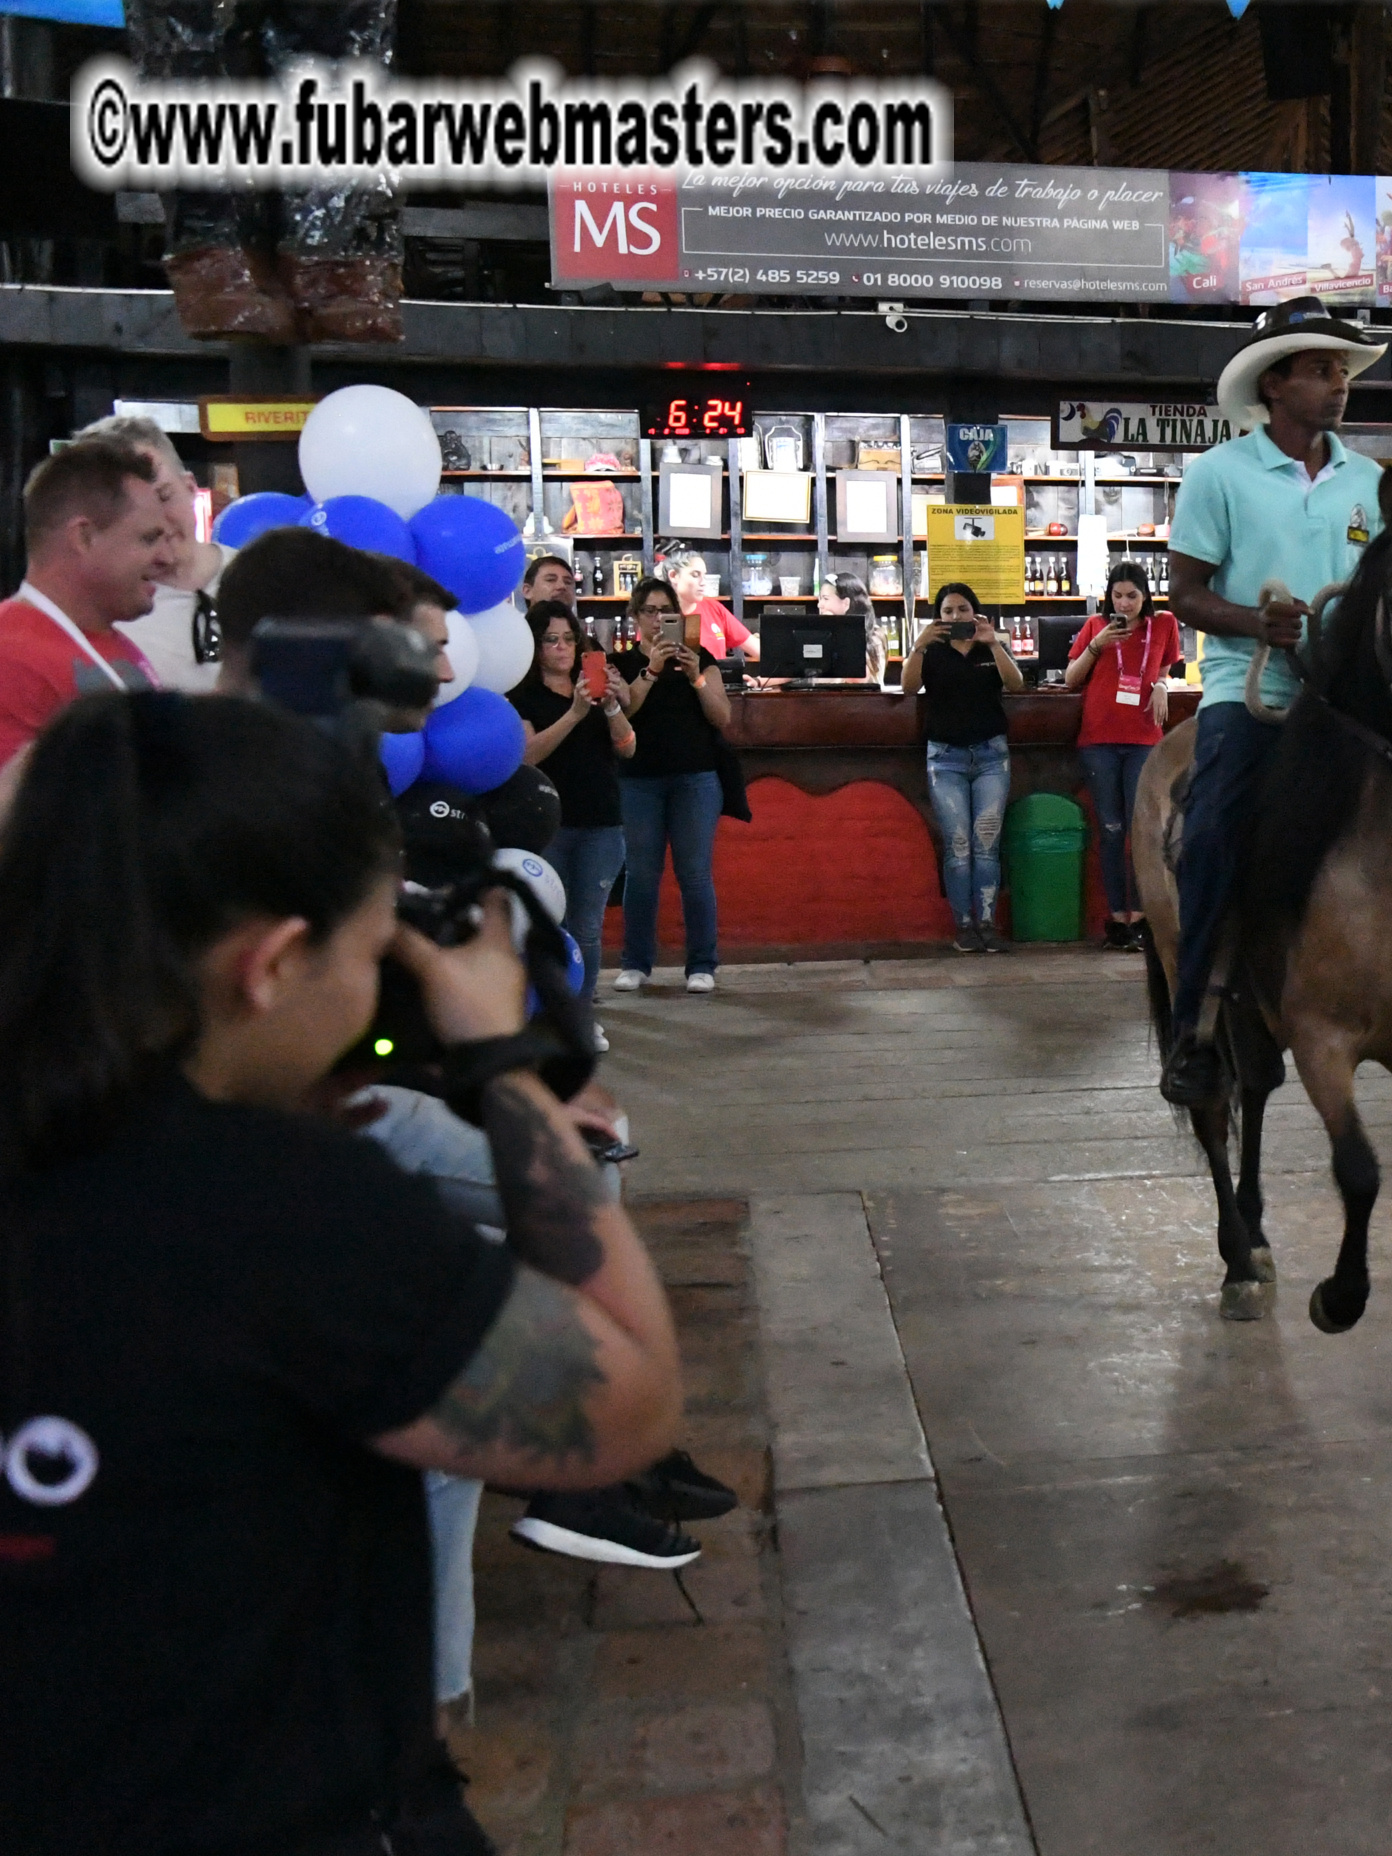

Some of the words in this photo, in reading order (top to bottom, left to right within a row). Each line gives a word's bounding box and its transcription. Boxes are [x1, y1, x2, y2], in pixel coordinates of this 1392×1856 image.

[573, 181, 658, 195] HOTELES
[711, 171, 768, 198] mejor
[773, 174, 836, 199] opción
[835, 176, 885, 201] para
[890, 173, 919, 194] tus
[925, 178, 979, 205] viajes
[985, 178, 1009, 198] de
[1014, 178, 1081, 209] trabajo
[1087, 188, 1099, 201] o
[1098, 182, 1164, 211] placer
[708, 205, 752, 217] MEJOR
[756, 207, 805, 219] PRECIO
[808, 209, 901, 223] GARANTIZADO
[905, 213, 932, 225] POR
[936, 214, 978, 226] MEDIO
[981, 215, 999, 226] DE
[1003, 216, 1060, 228] NUESTRA
[1063, 217, 1109, 231] PÁGINA
[1112, 219, 1140, 231] WEB
[574, 199, 661, 255] MS
[824, 230, 1032, 253] www.hotelesms.com
[694, 267, 750, 284] +57(2)
[756, 269, 790, 283] 485
[796, 270, 840, 284] 5259
[862, 273, 882, 286] 01
[887, 274, 934, 288] 8000
[939, 275, 1003, 290] 910098
[1192, 275, 1217, 290] Cali
[1245, 279, 1265, 292] San
[1267, 274, 1304, 288] Andrés
[1024, 277, 1168, 292] reservas@hotelesms.com
[1314, 276, 1372, 293] Villavicencio
[244, 410, 309, 425] RIVERIT
[668, 399, 743, 428] 6:24
[1150, 405, 1208, 418] TIENDA
[959, 427, 994, 441] CAJA
[1122, 417, 1149, 443] LA
[1157, 418, 1232, 445] TINAJA
